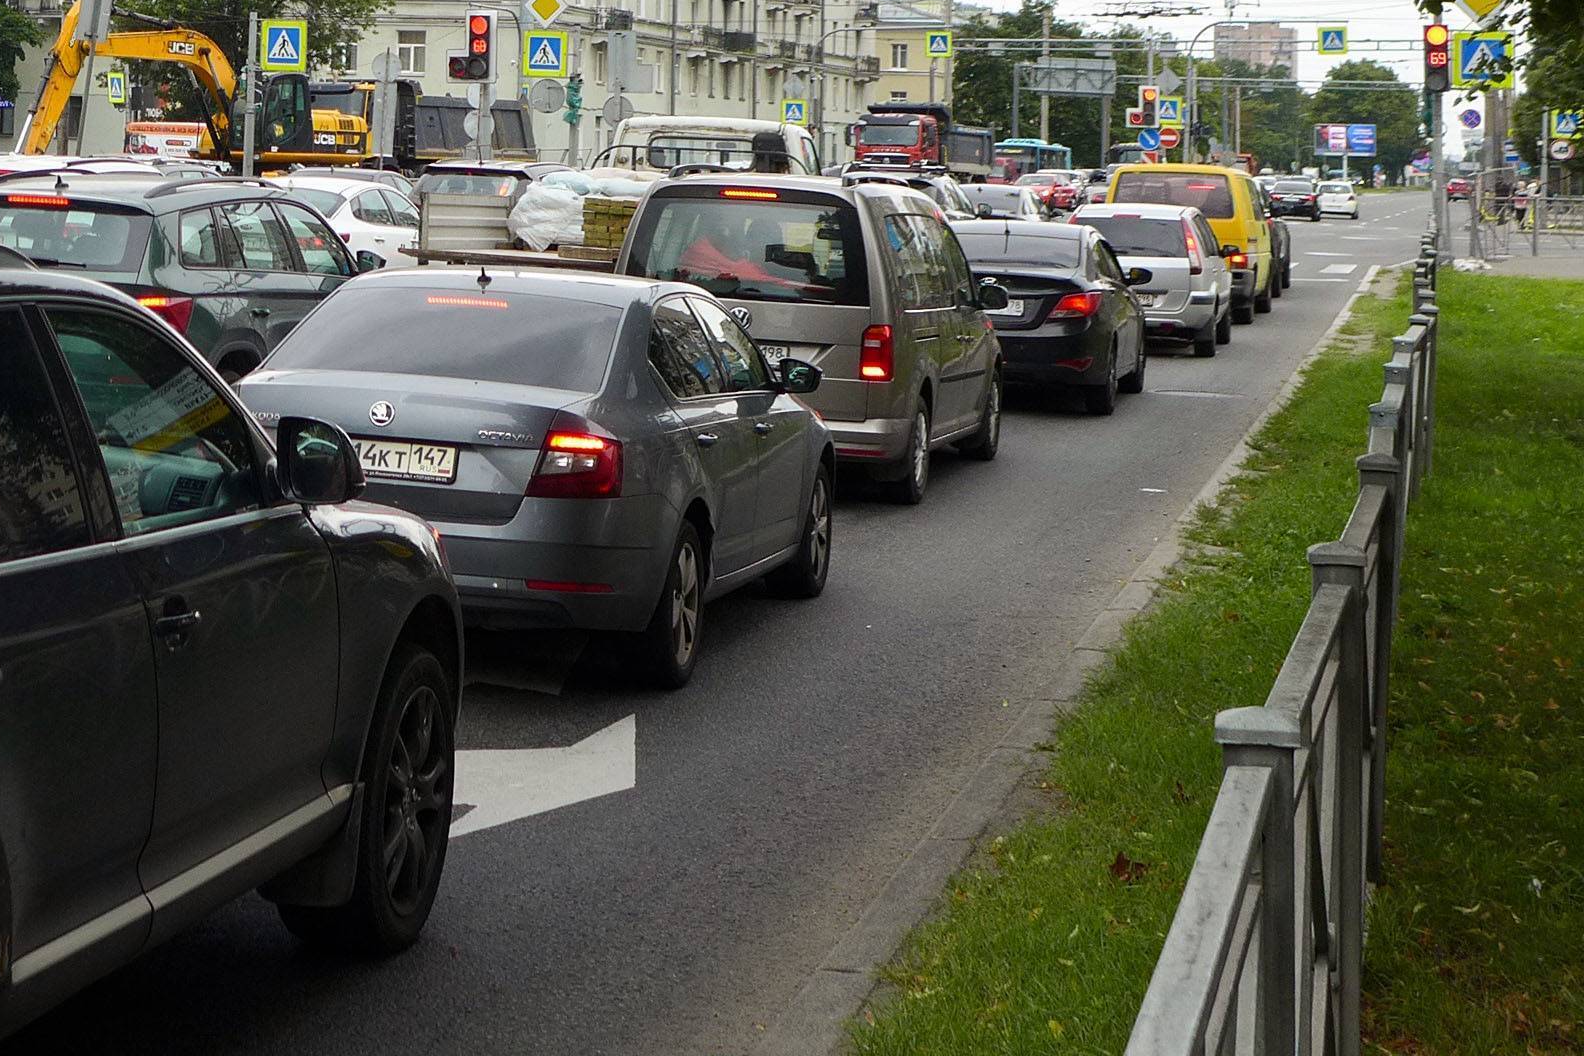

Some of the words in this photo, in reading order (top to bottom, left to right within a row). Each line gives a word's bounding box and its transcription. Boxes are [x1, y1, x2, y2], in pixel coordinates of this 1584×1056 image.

[168, 41, 195, 55] JCB
[1430, 52, 1447, 65] 69
[314, 134, 336, 144] JCB
[477, 430, 535, 442] OCTAVIA
[413, 447, 448, 467] 147
[419, 464, 438, 474] RUS
